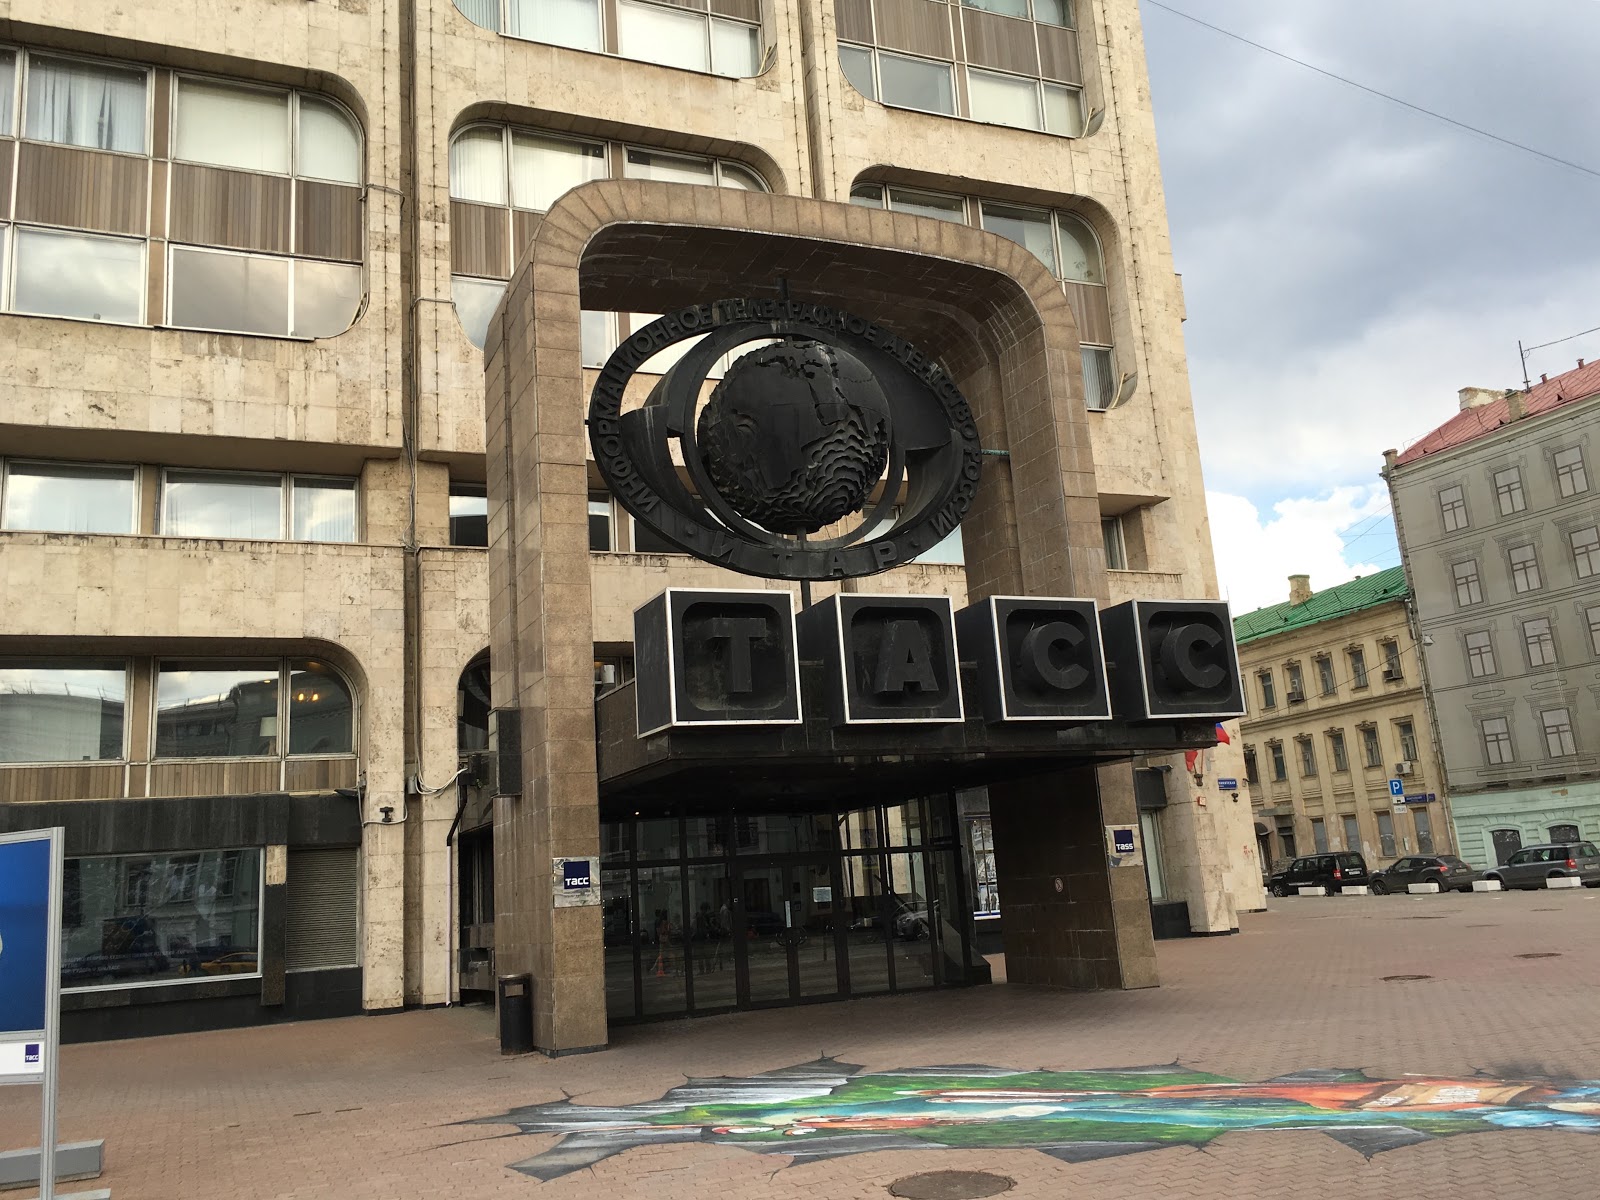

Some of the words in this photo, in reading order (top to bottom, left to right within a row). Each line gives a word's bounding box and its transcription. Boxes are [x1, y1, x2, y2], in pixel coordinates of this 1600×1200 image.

[597, 303, 714, 515] ИНФОРМАЦИОННОЕ
[721, 298, 880, 343] ТЕЛЕГРАФНОЕ
[929, 445, 980, 537] РОССИИ
[711, 531, 899, 577] ИТАР
[705, 616, 1225, 693] ТАСС
[1392, 781, 1400, 794] P
